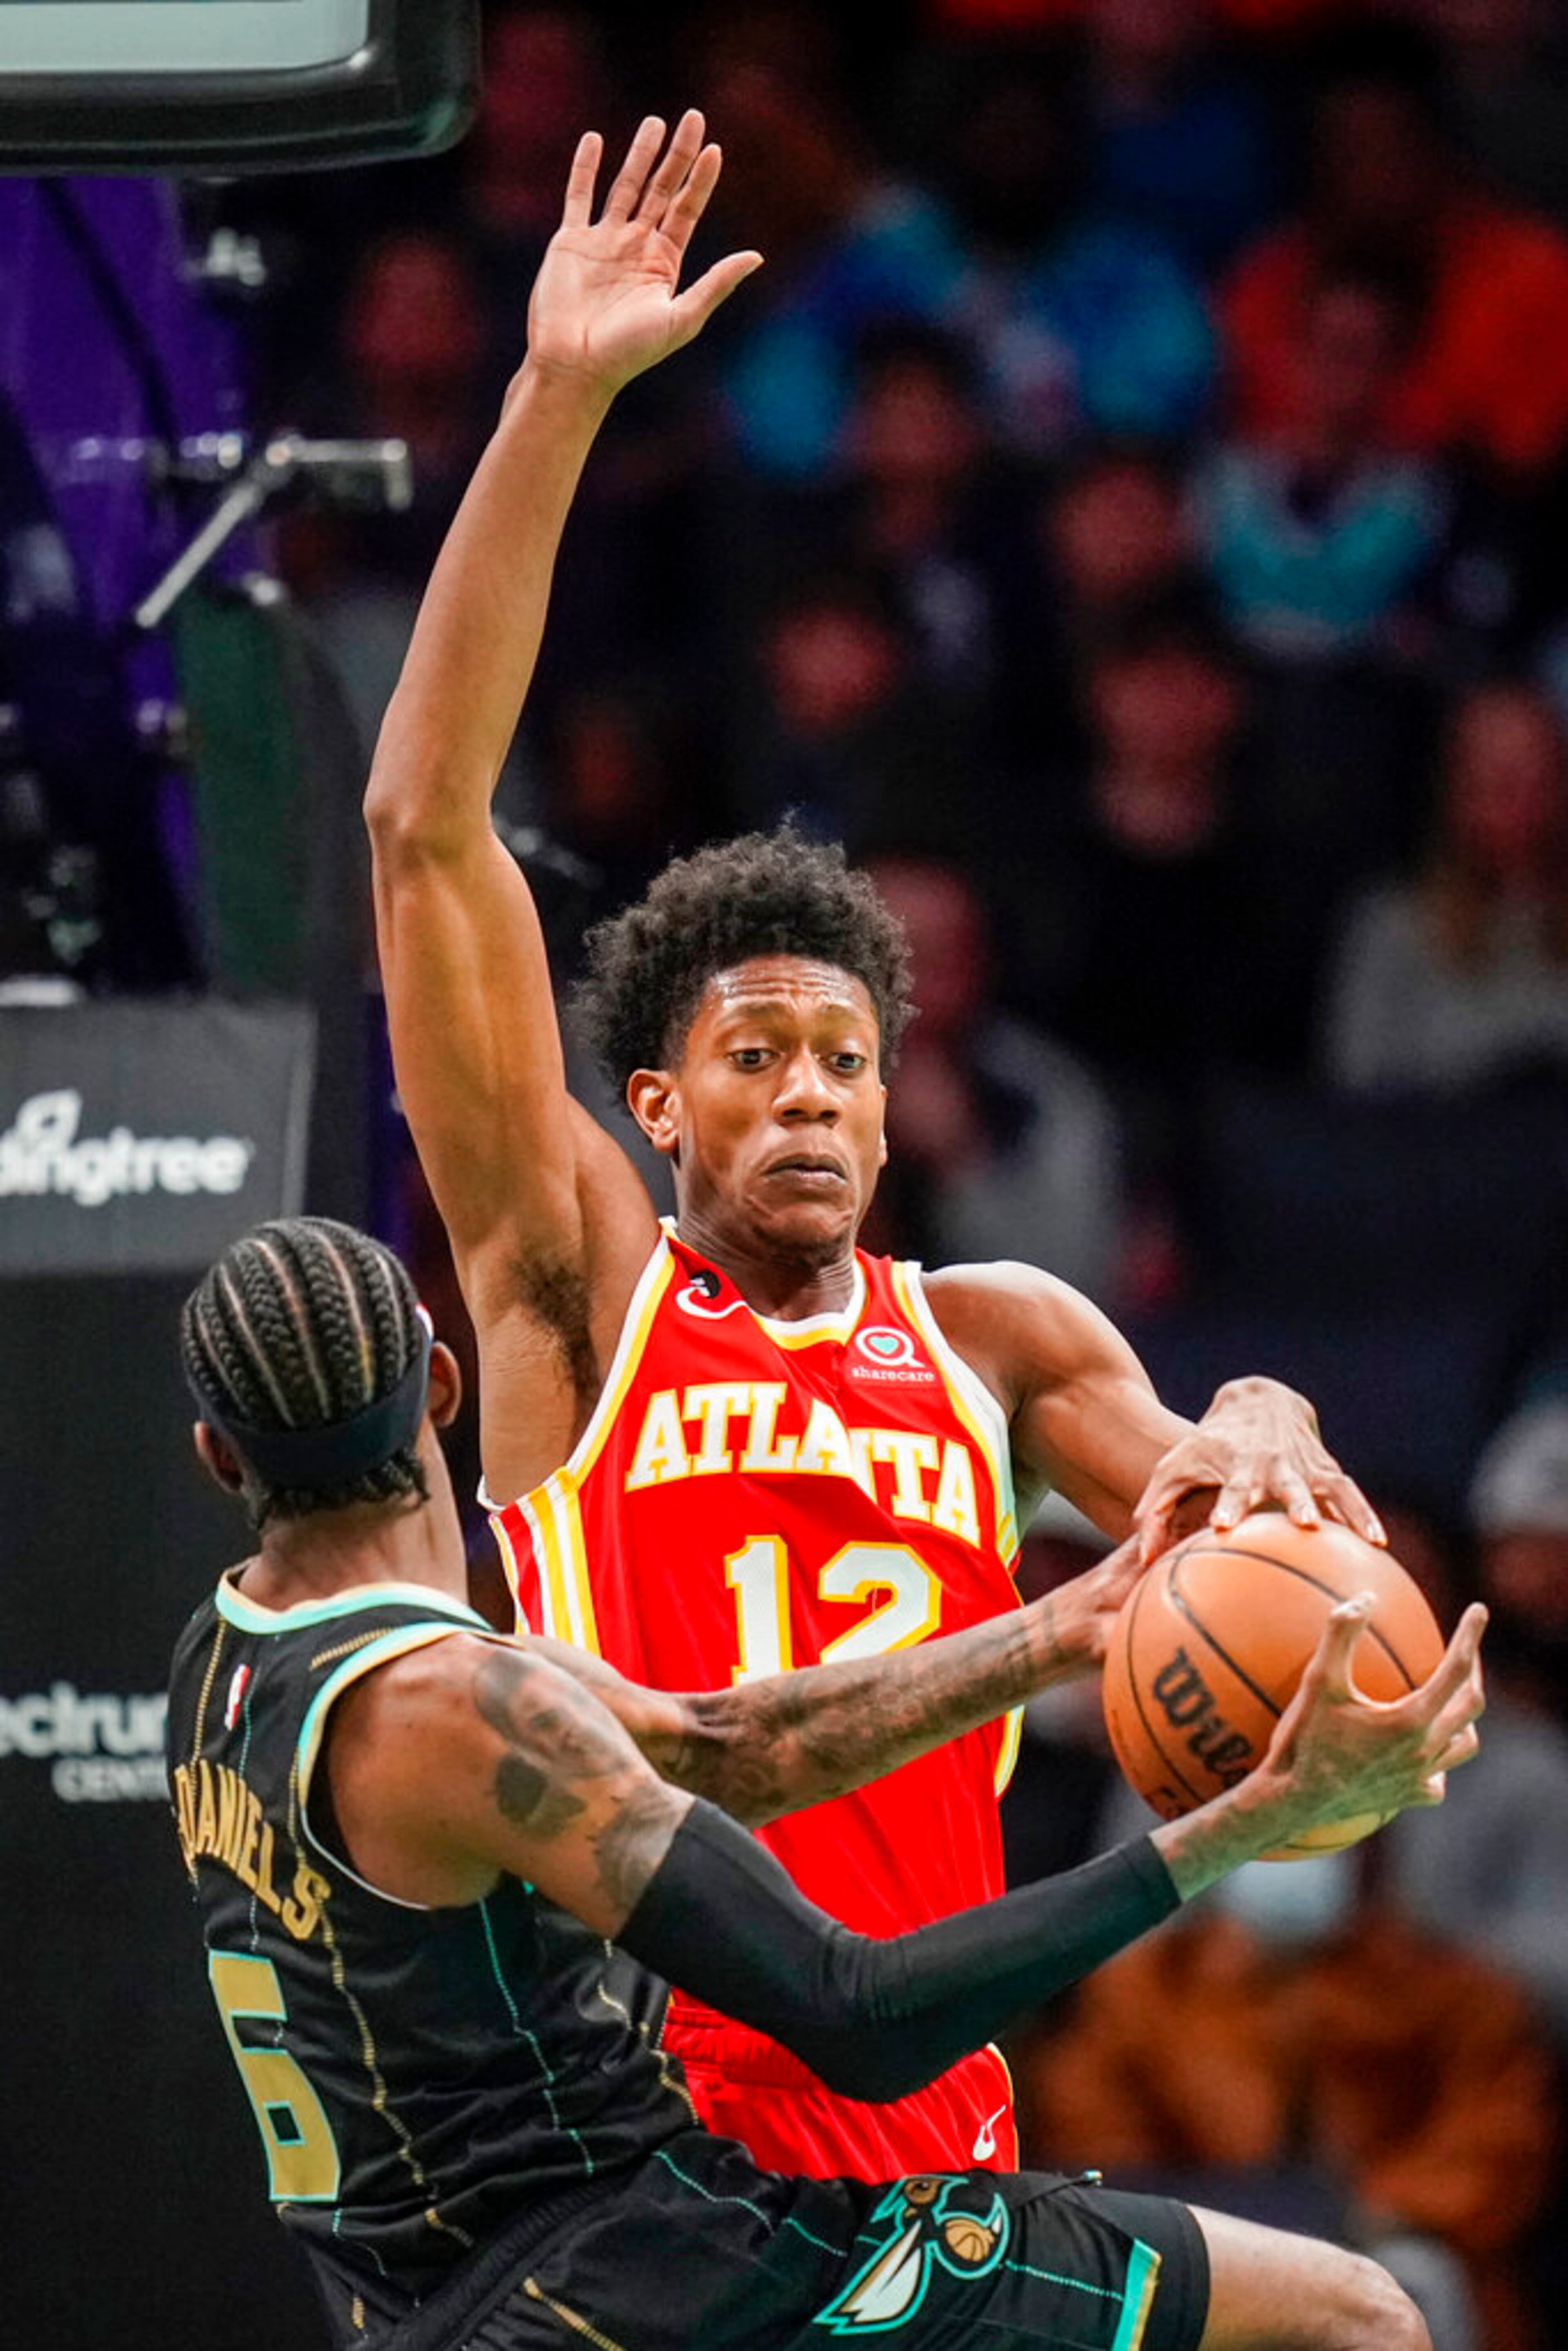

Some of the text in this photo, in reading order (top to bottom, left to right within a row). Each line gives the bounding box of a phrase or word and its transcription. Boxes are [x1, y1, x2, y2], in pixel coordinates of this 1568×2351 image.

[851, 1366, 935, 1382] sharecare
[724, 1534, 942, 1687] 12
[174, 1758, 330, 1941] DANIELS
[208, 1949, 340, 2202] 6
